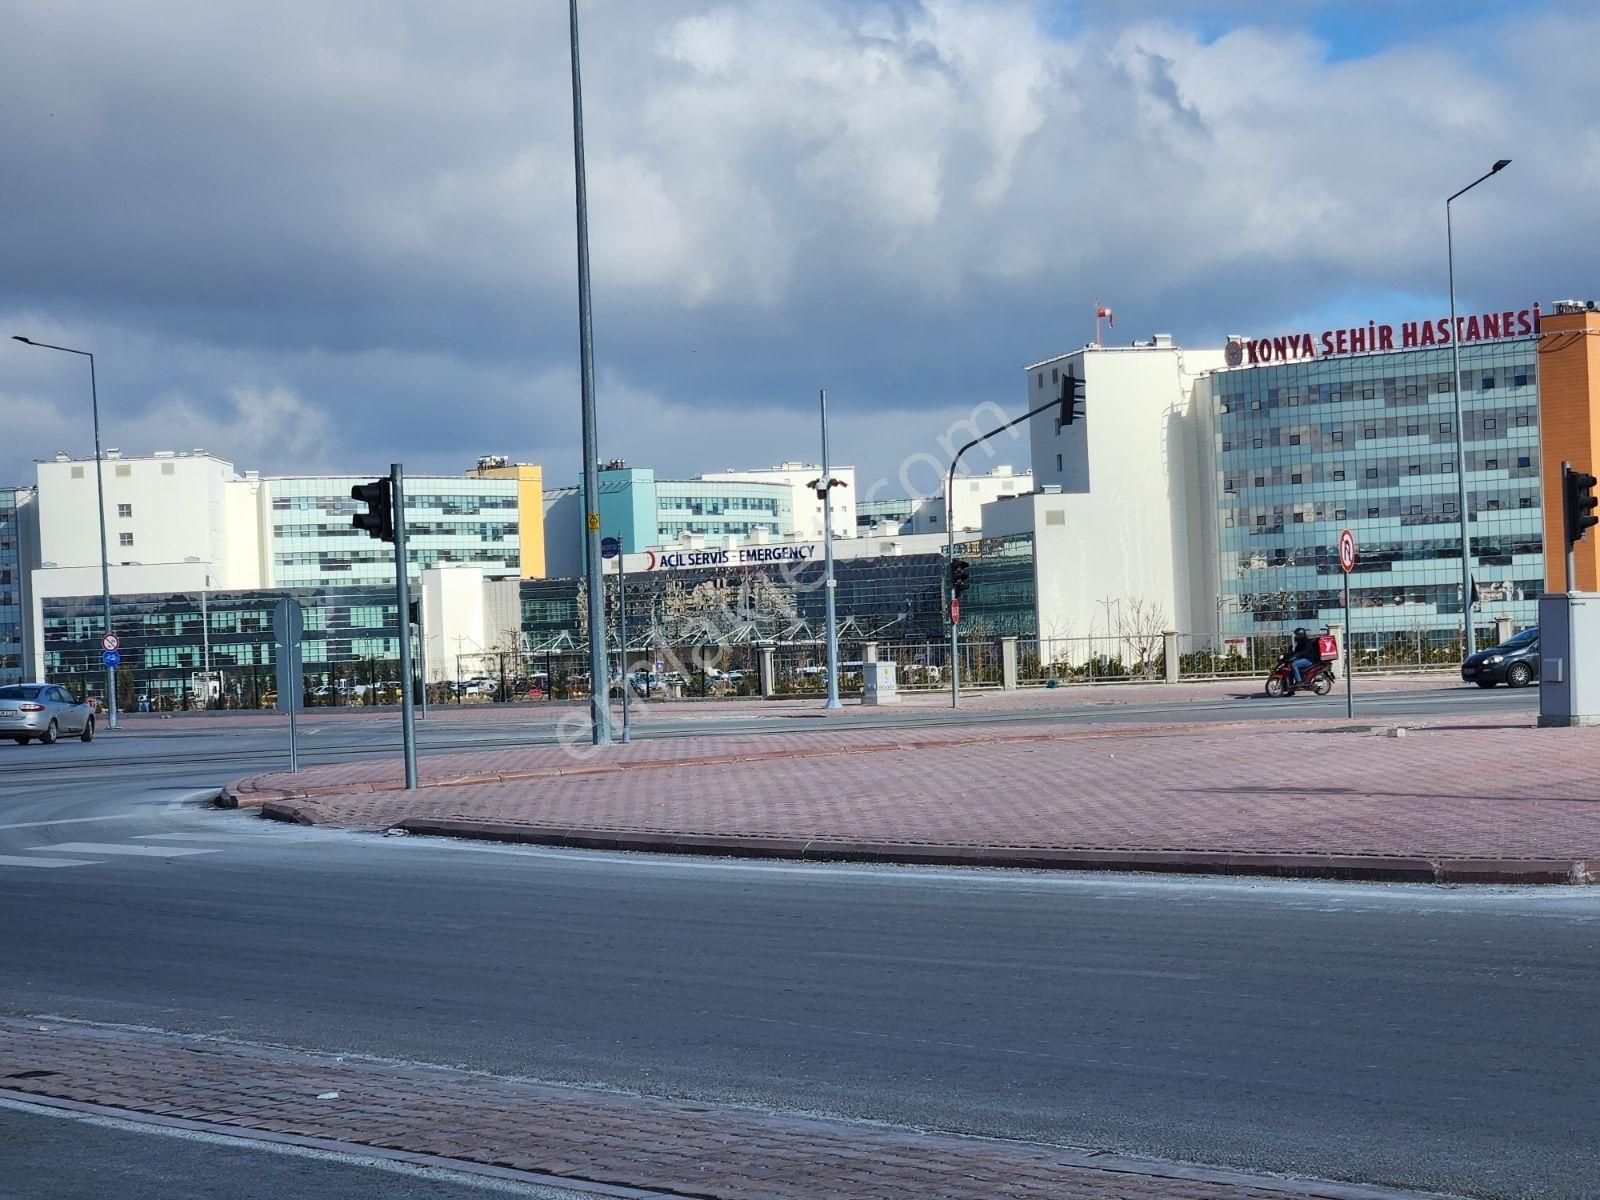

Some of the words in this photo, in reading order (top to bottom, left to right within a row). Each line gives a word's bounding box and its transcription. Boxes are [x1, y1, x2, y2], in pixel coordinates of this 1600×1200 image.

[1247, 333, 1315, 364] KONYA
[1403, 303, 1540, 348] HASTANESİ
[660, 551, 686, 567] ACİL
[690, 550, 729, 565] SERVİS
[739, 545, 815, 562] EMERGENCY
